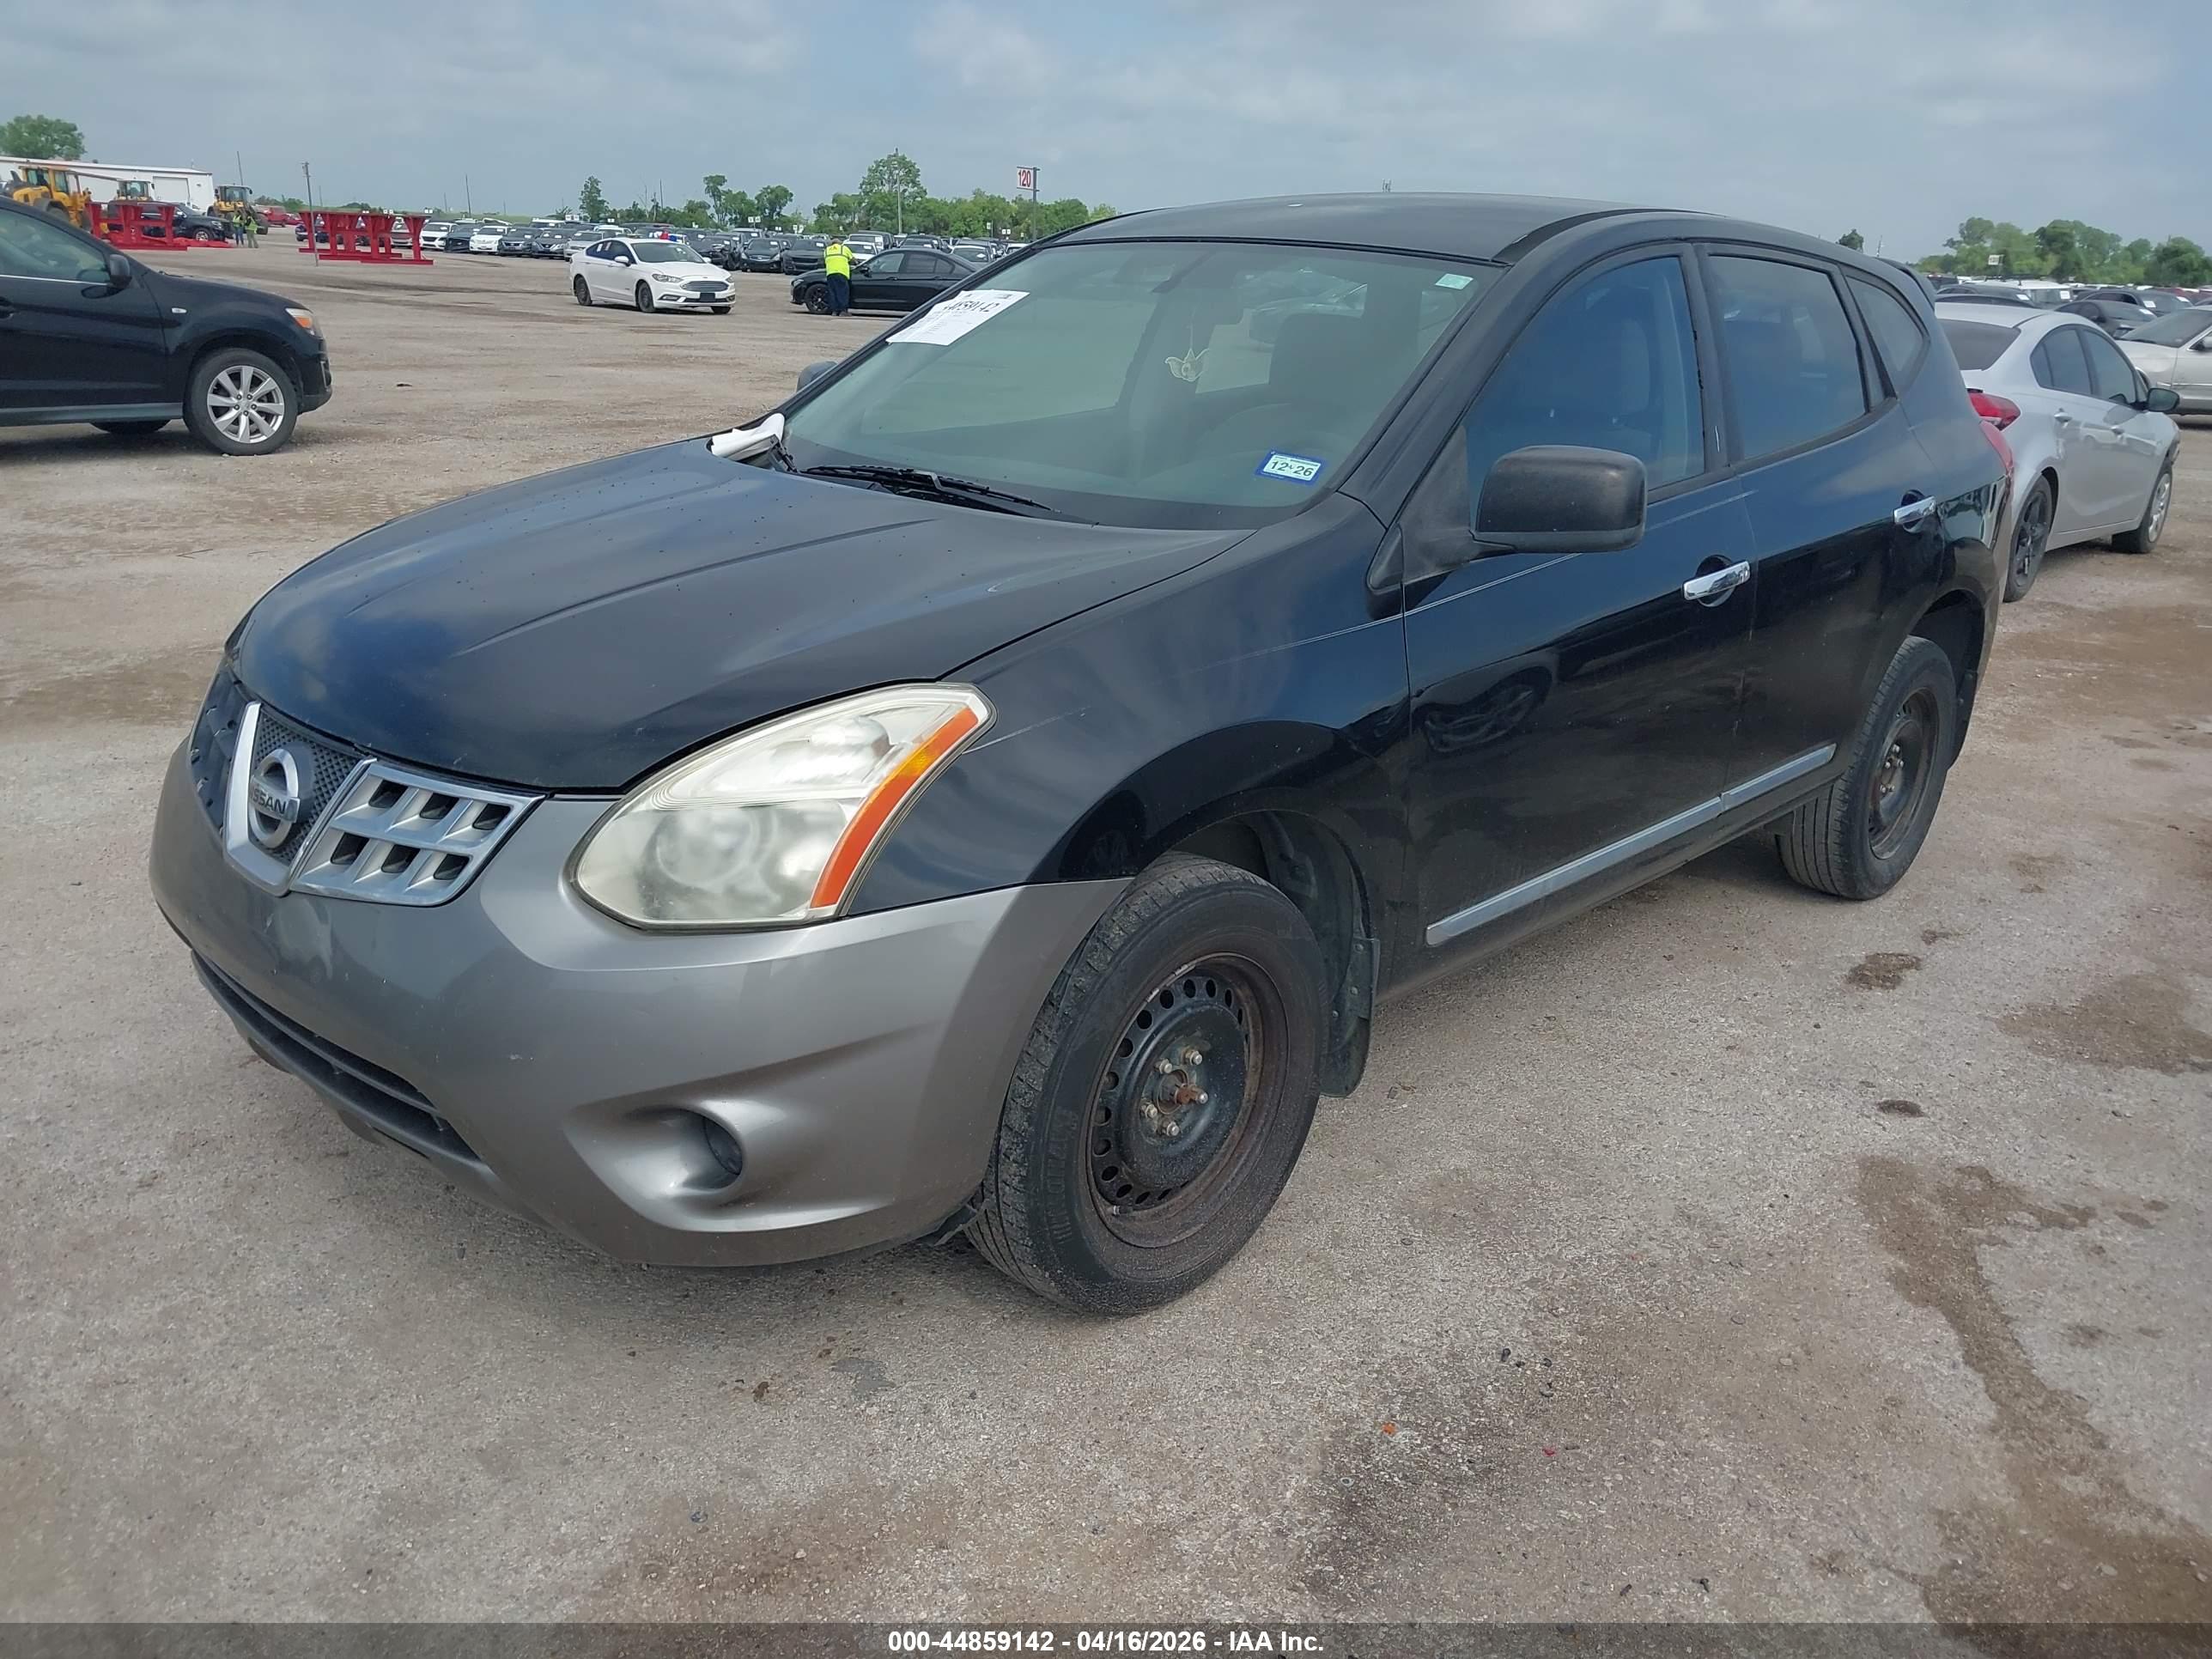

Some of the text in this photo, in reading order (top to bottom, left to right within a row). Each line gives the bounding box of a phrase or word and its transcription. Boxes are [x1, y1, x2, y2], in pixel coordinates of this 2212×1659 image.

[1018, 169, 1031, 187] 120
[1271, 460, 1288, 471] 12
[1293, 465, 1315, 477] 26
